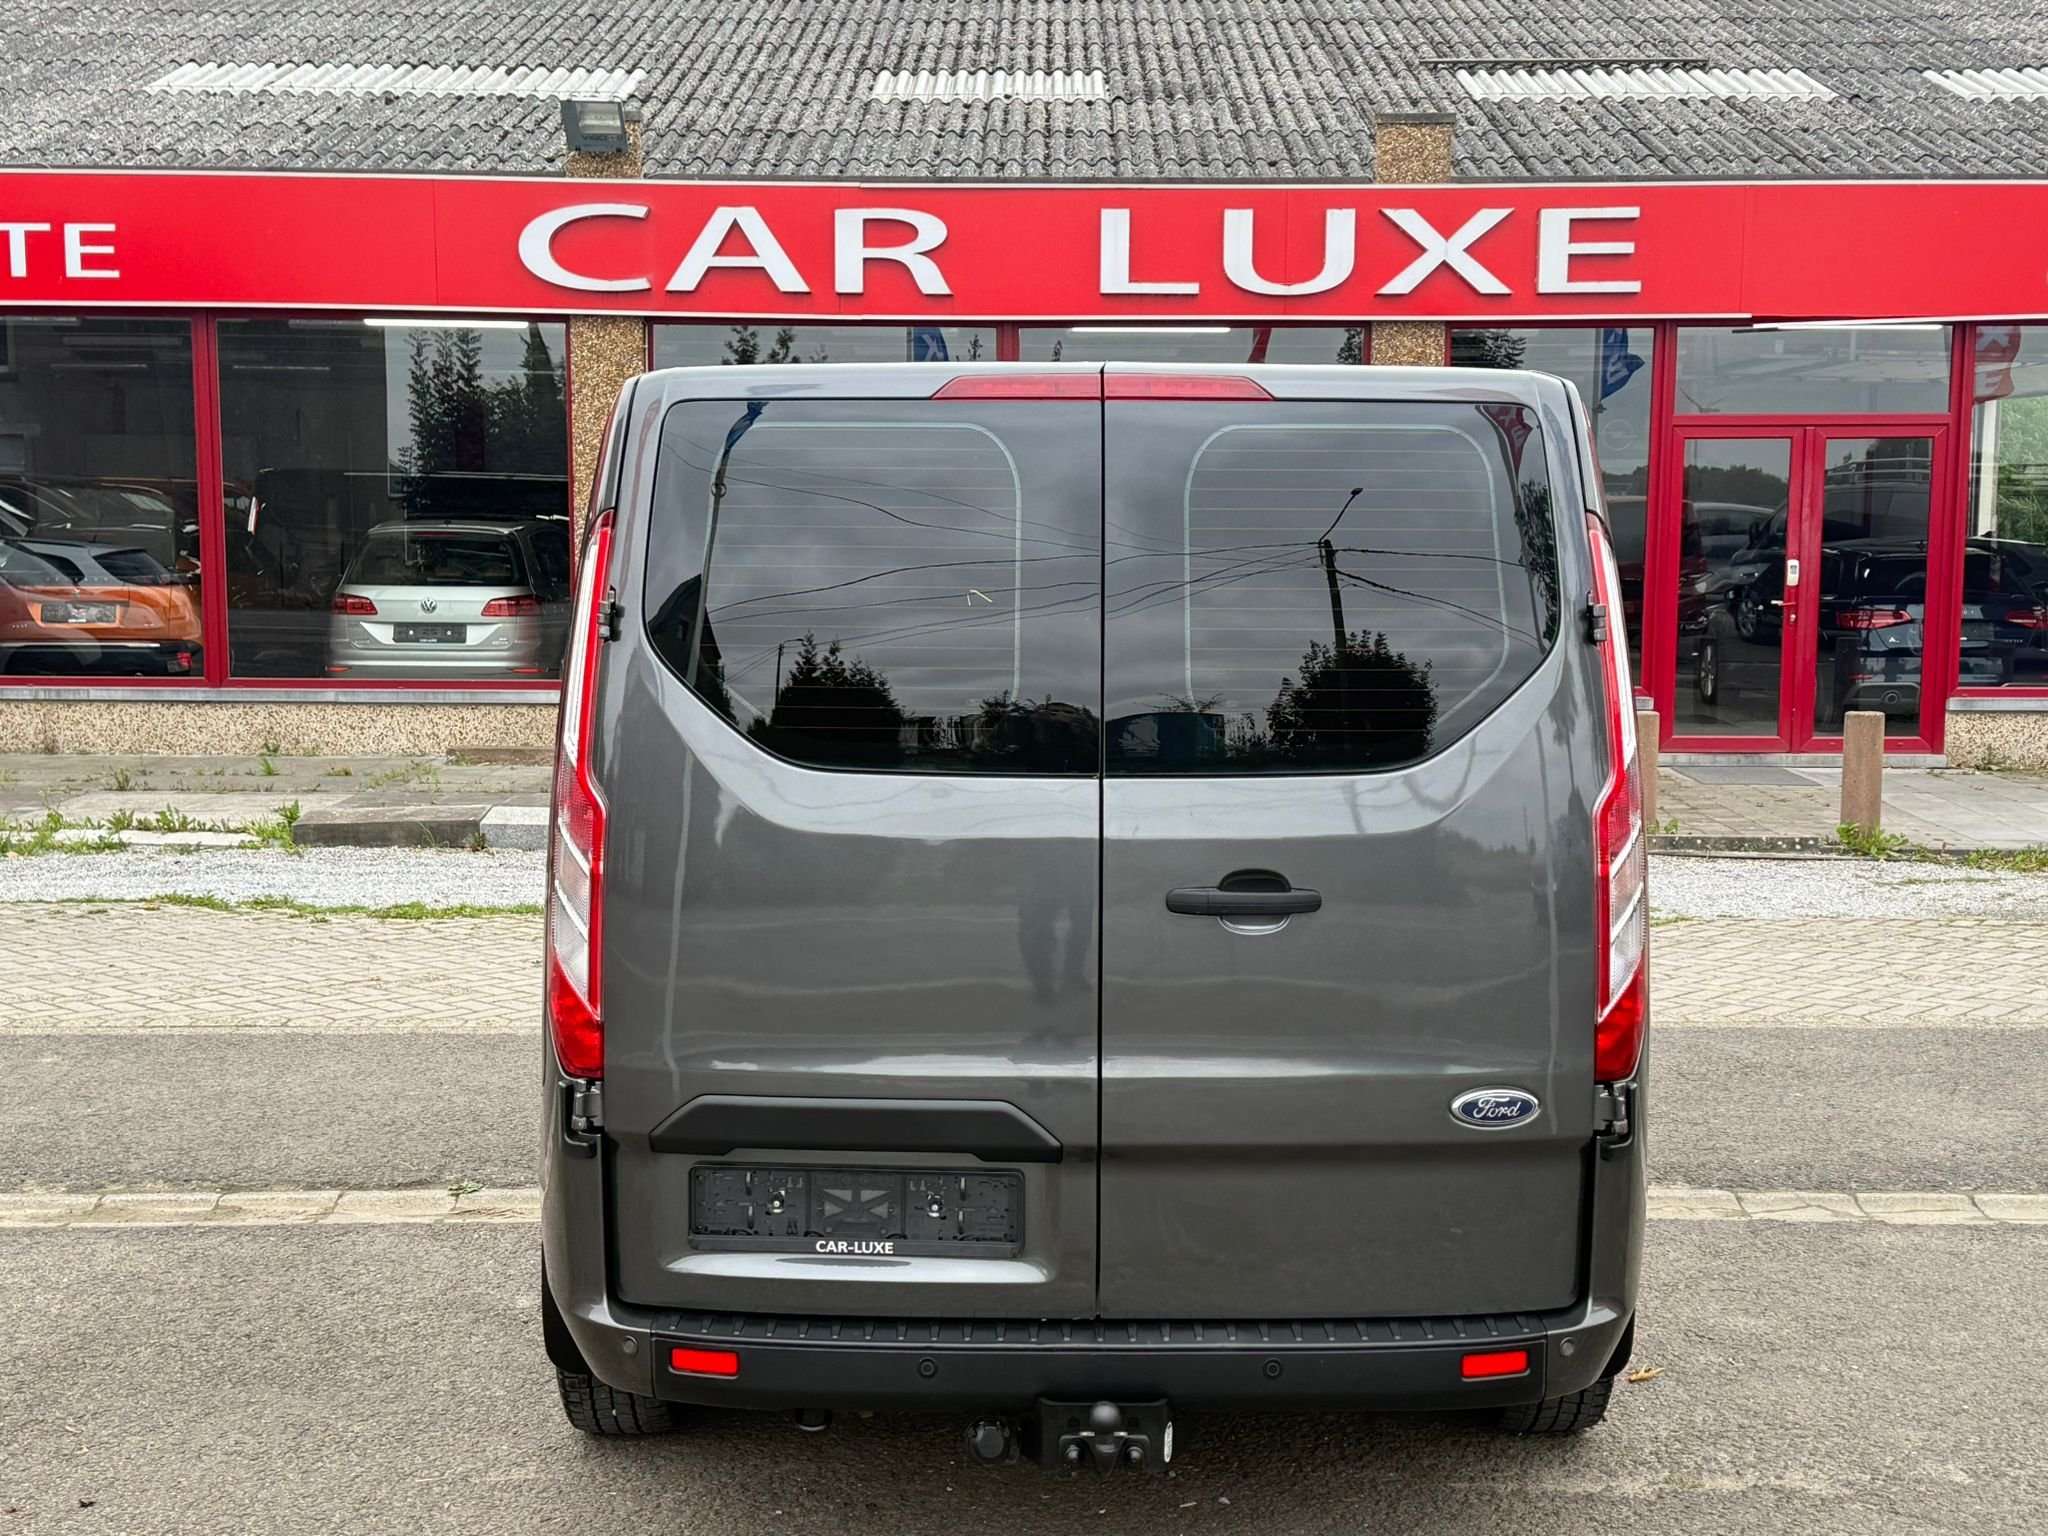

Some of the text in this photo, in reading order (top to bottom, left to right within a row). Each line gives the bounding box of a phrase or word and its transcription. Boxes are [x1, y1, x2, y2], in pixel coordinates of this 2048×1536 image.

[518, 203, 1643, 297] CAR LUXE
[1472, 1096, 1522, 1119] Ford
[815, 1240, 895, 1255] CAR-LUXE
